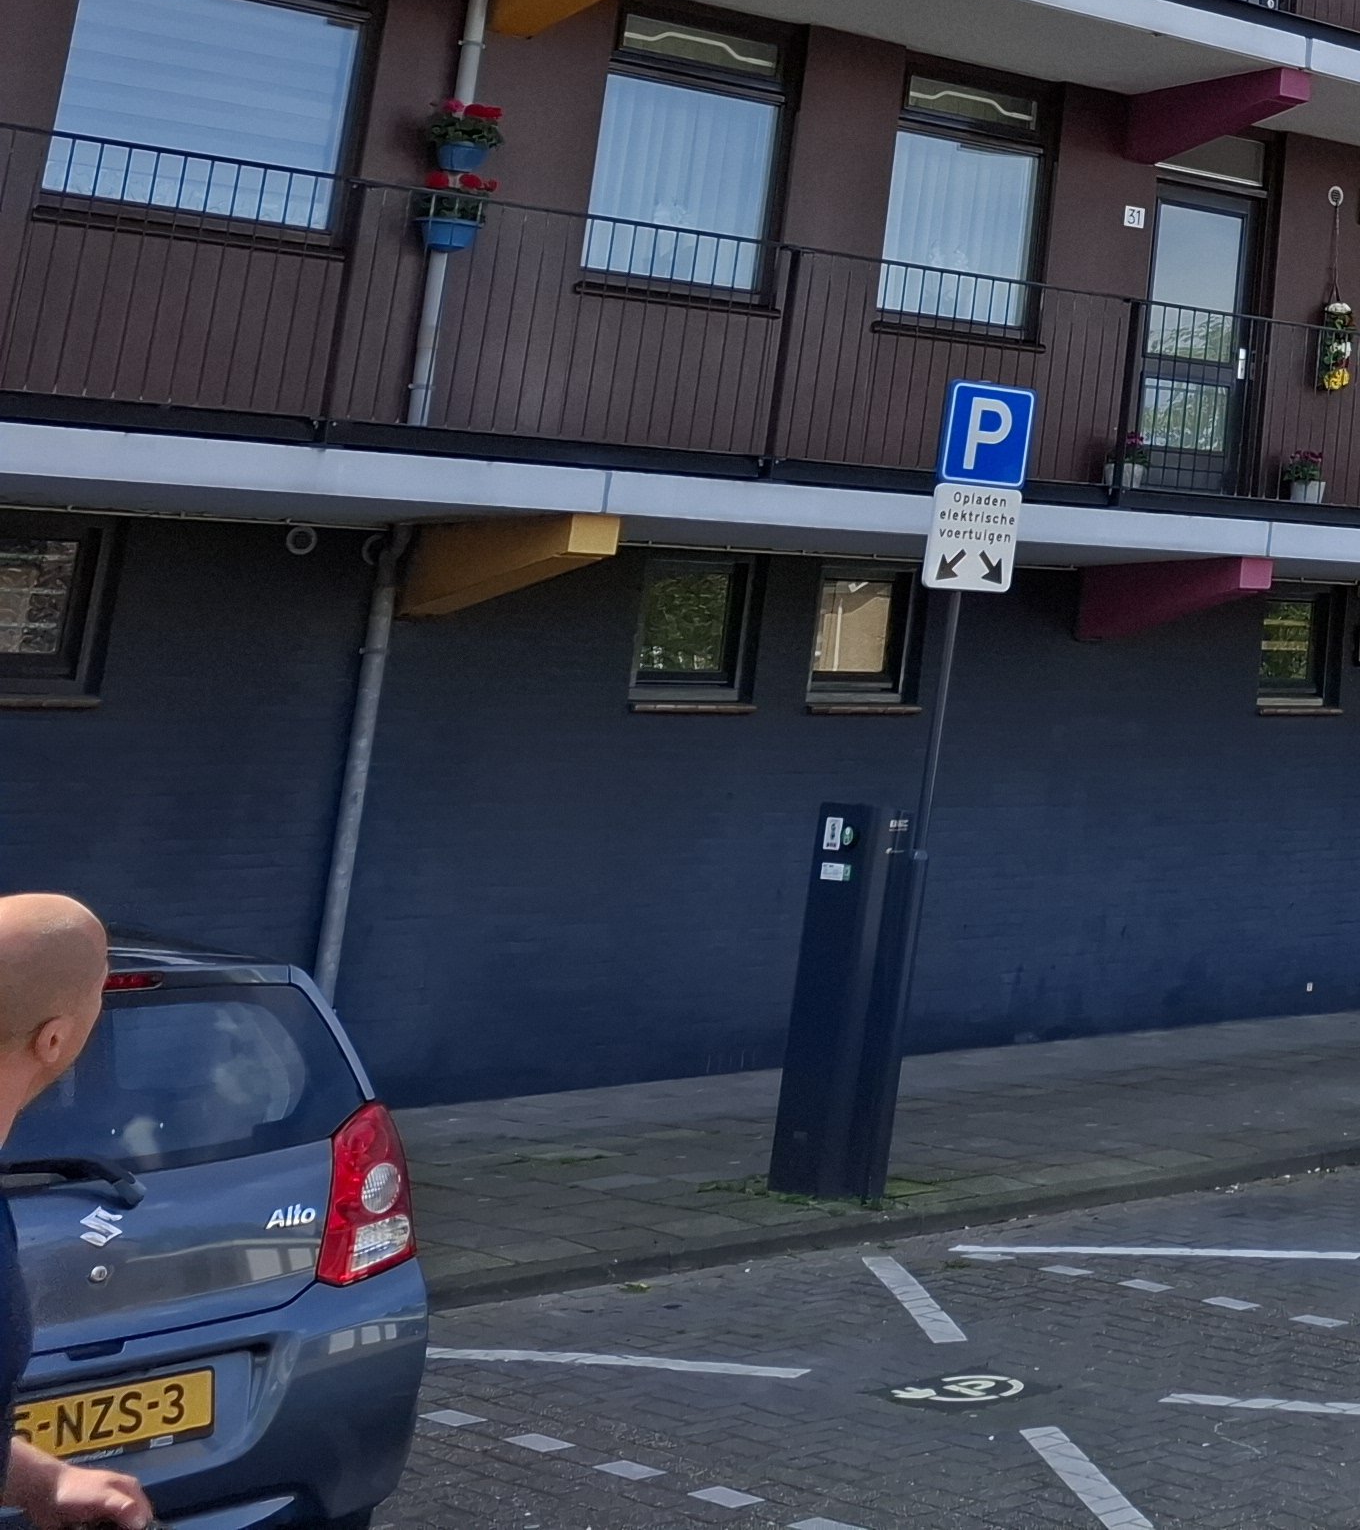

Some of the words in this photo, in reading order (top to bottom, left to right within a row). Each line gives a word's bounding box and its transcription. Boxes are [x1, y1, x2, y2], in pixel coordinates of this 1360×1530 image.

[1127, 208, 1141, 225] 31
[963, 396, 1013, 470] P
[953, 491, 1007, 507] Opladen
[939, 508, 1015, 526] elektrische
[939, 528, 1011, 545] voertuigen
[265, 1203, 316, 1230] Alto
